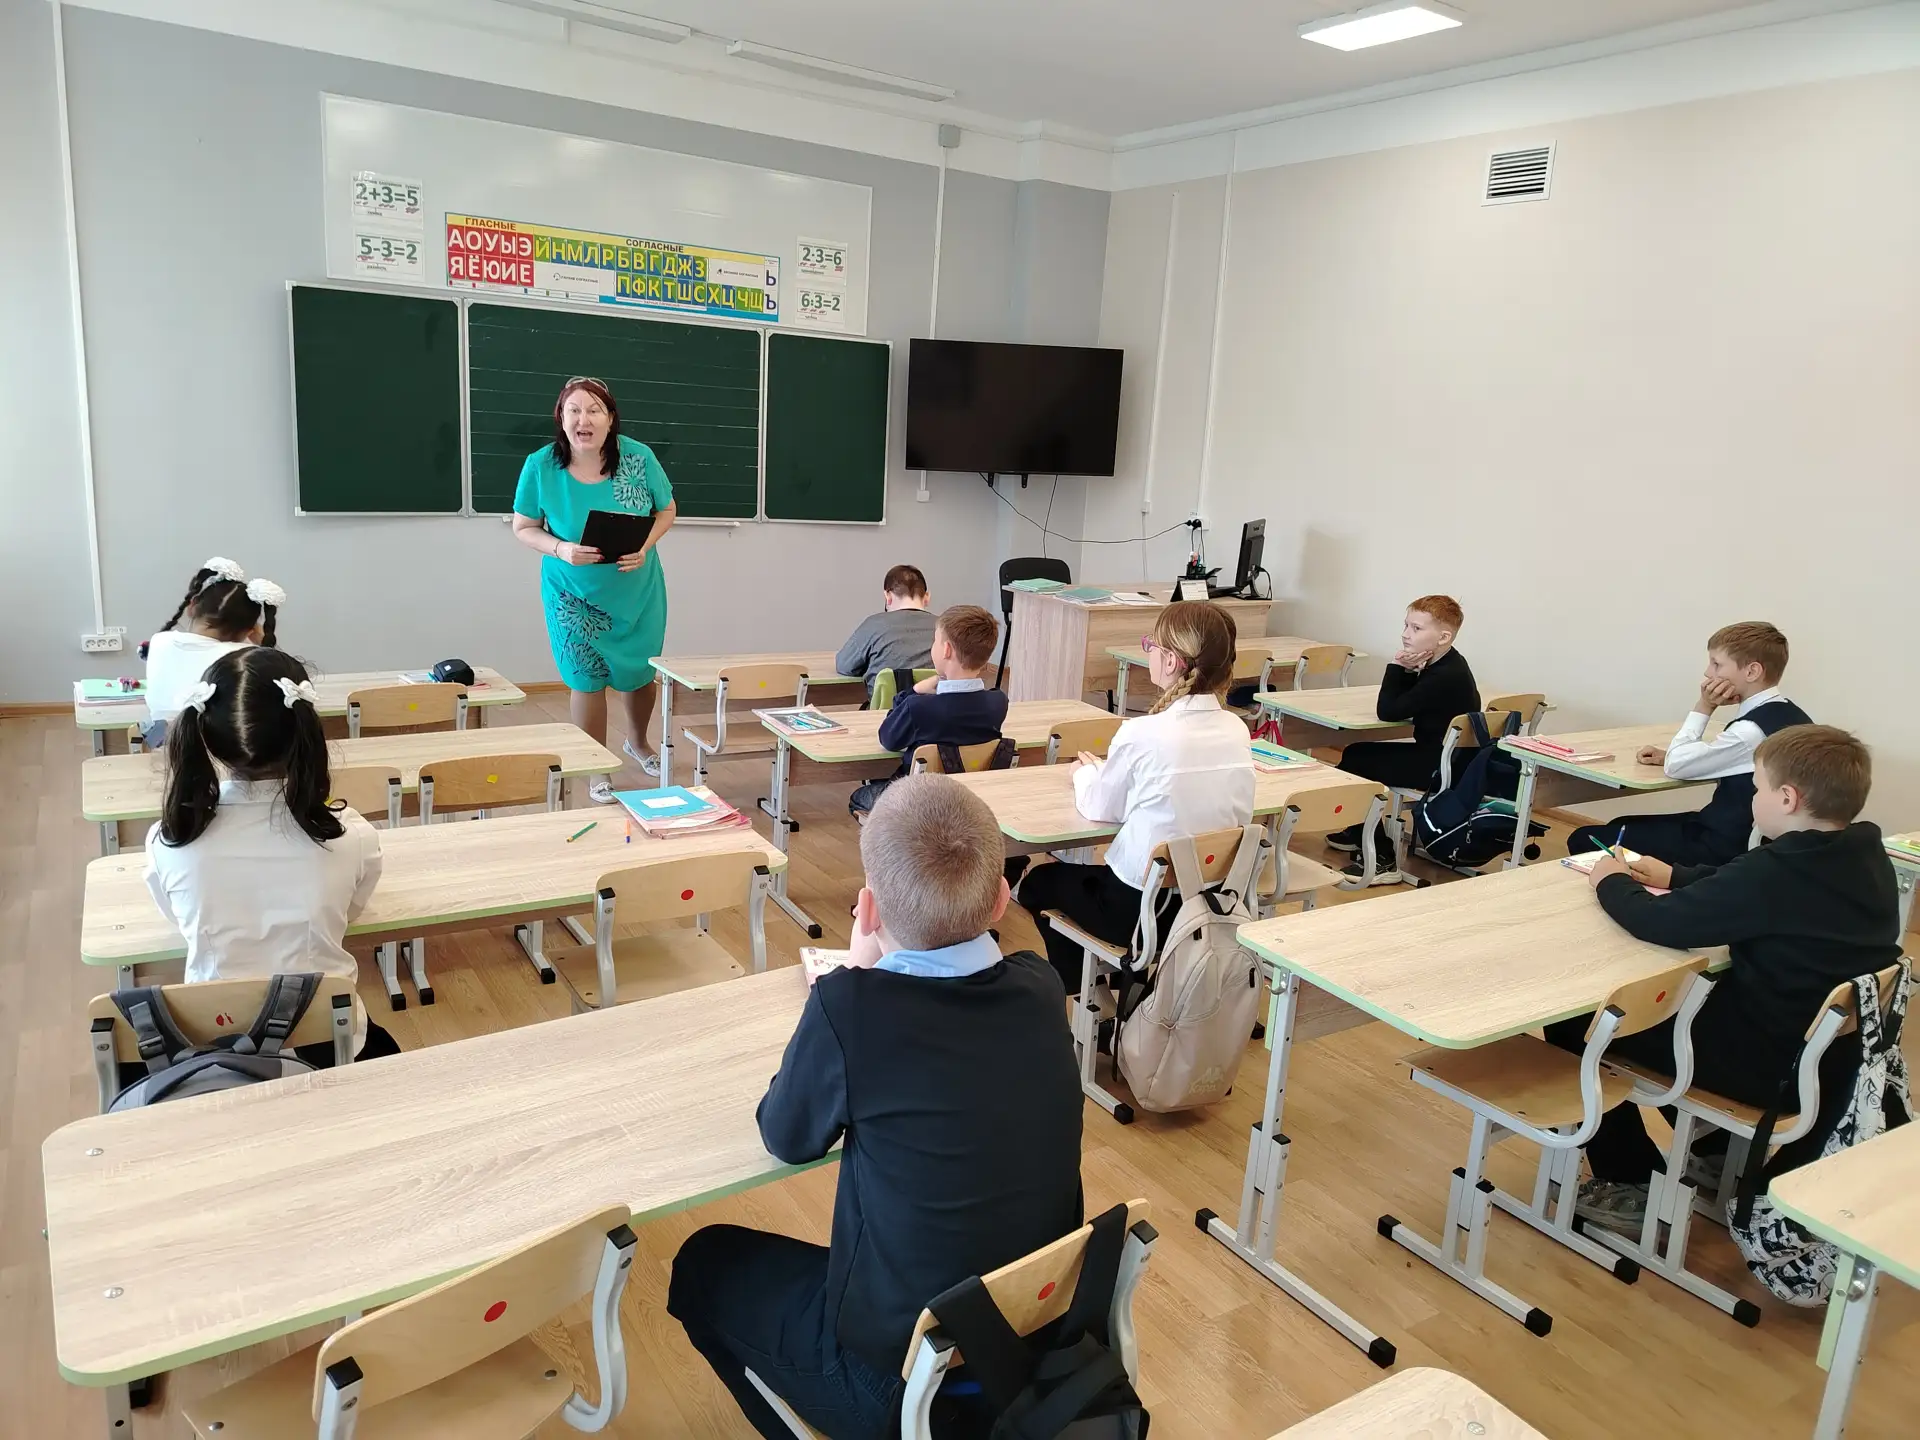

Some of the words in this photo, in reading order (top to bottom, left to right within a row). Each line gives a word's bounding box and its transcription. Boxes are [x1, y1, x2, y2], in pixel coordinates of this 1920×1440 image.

[355, 182, 419, 206] 2+3=5
[465, 217, 517, 231] ГЛАСНЫЕ
[360, 238, 418, 261] 5-3=2
[626, 238, 684, 253] СОГЛАСНЫЕ
[801, 293, 841, 311] 6:3=2
